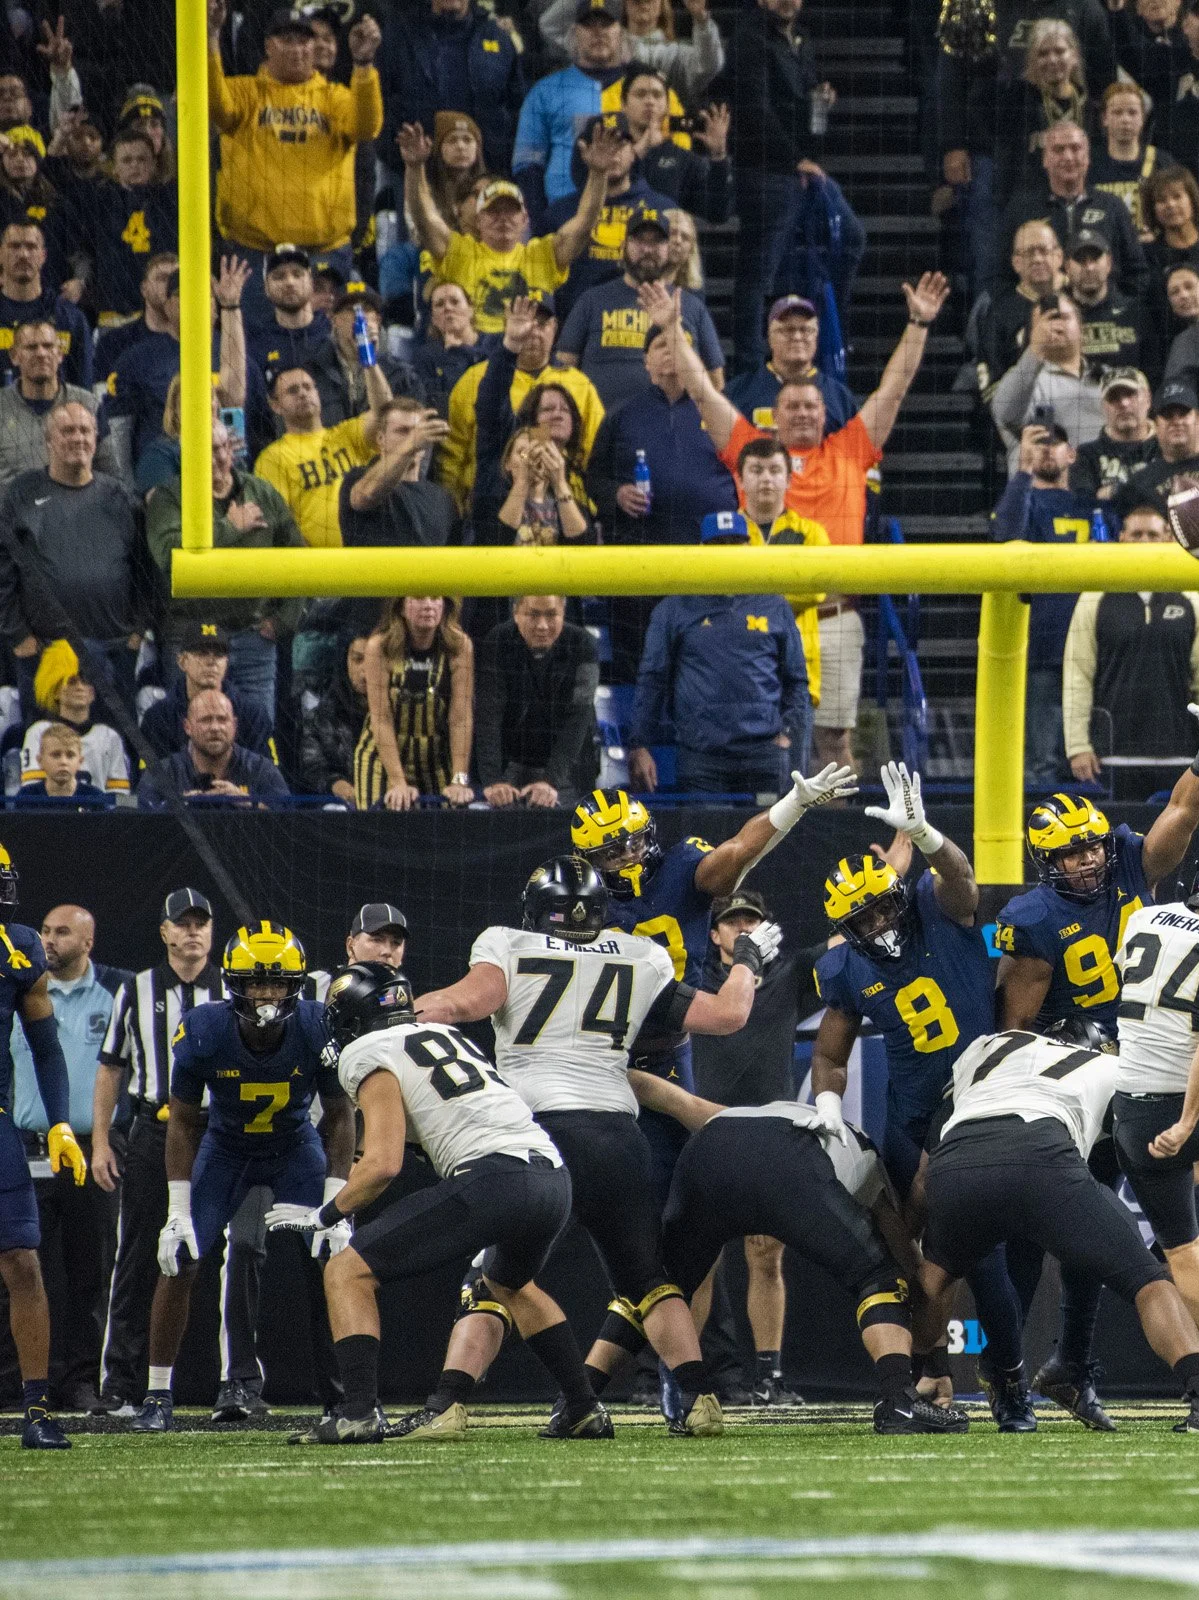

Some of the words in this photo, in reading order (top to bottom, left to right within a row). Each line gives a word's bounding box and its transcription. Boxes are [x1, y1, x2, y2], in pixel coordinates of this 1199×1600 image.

[121, 211, 151, 253] 4
[717, 511, 734, 530] C
[1053, 517, 1090, 543] 7
[201, 624, 218, 637] M
[746, 614, 769, 633] M
[901, 773, 916, 821] MICHIGAN
[546, 935, 561, 951] E.
[568, 939, 622, 955] MILLER
[155, 1001, 165, 1013] S
[512, 956, 636, 1051] 74
[893, 975, 961, 1054] 8
[240, 1081, 291, 1133] 7
